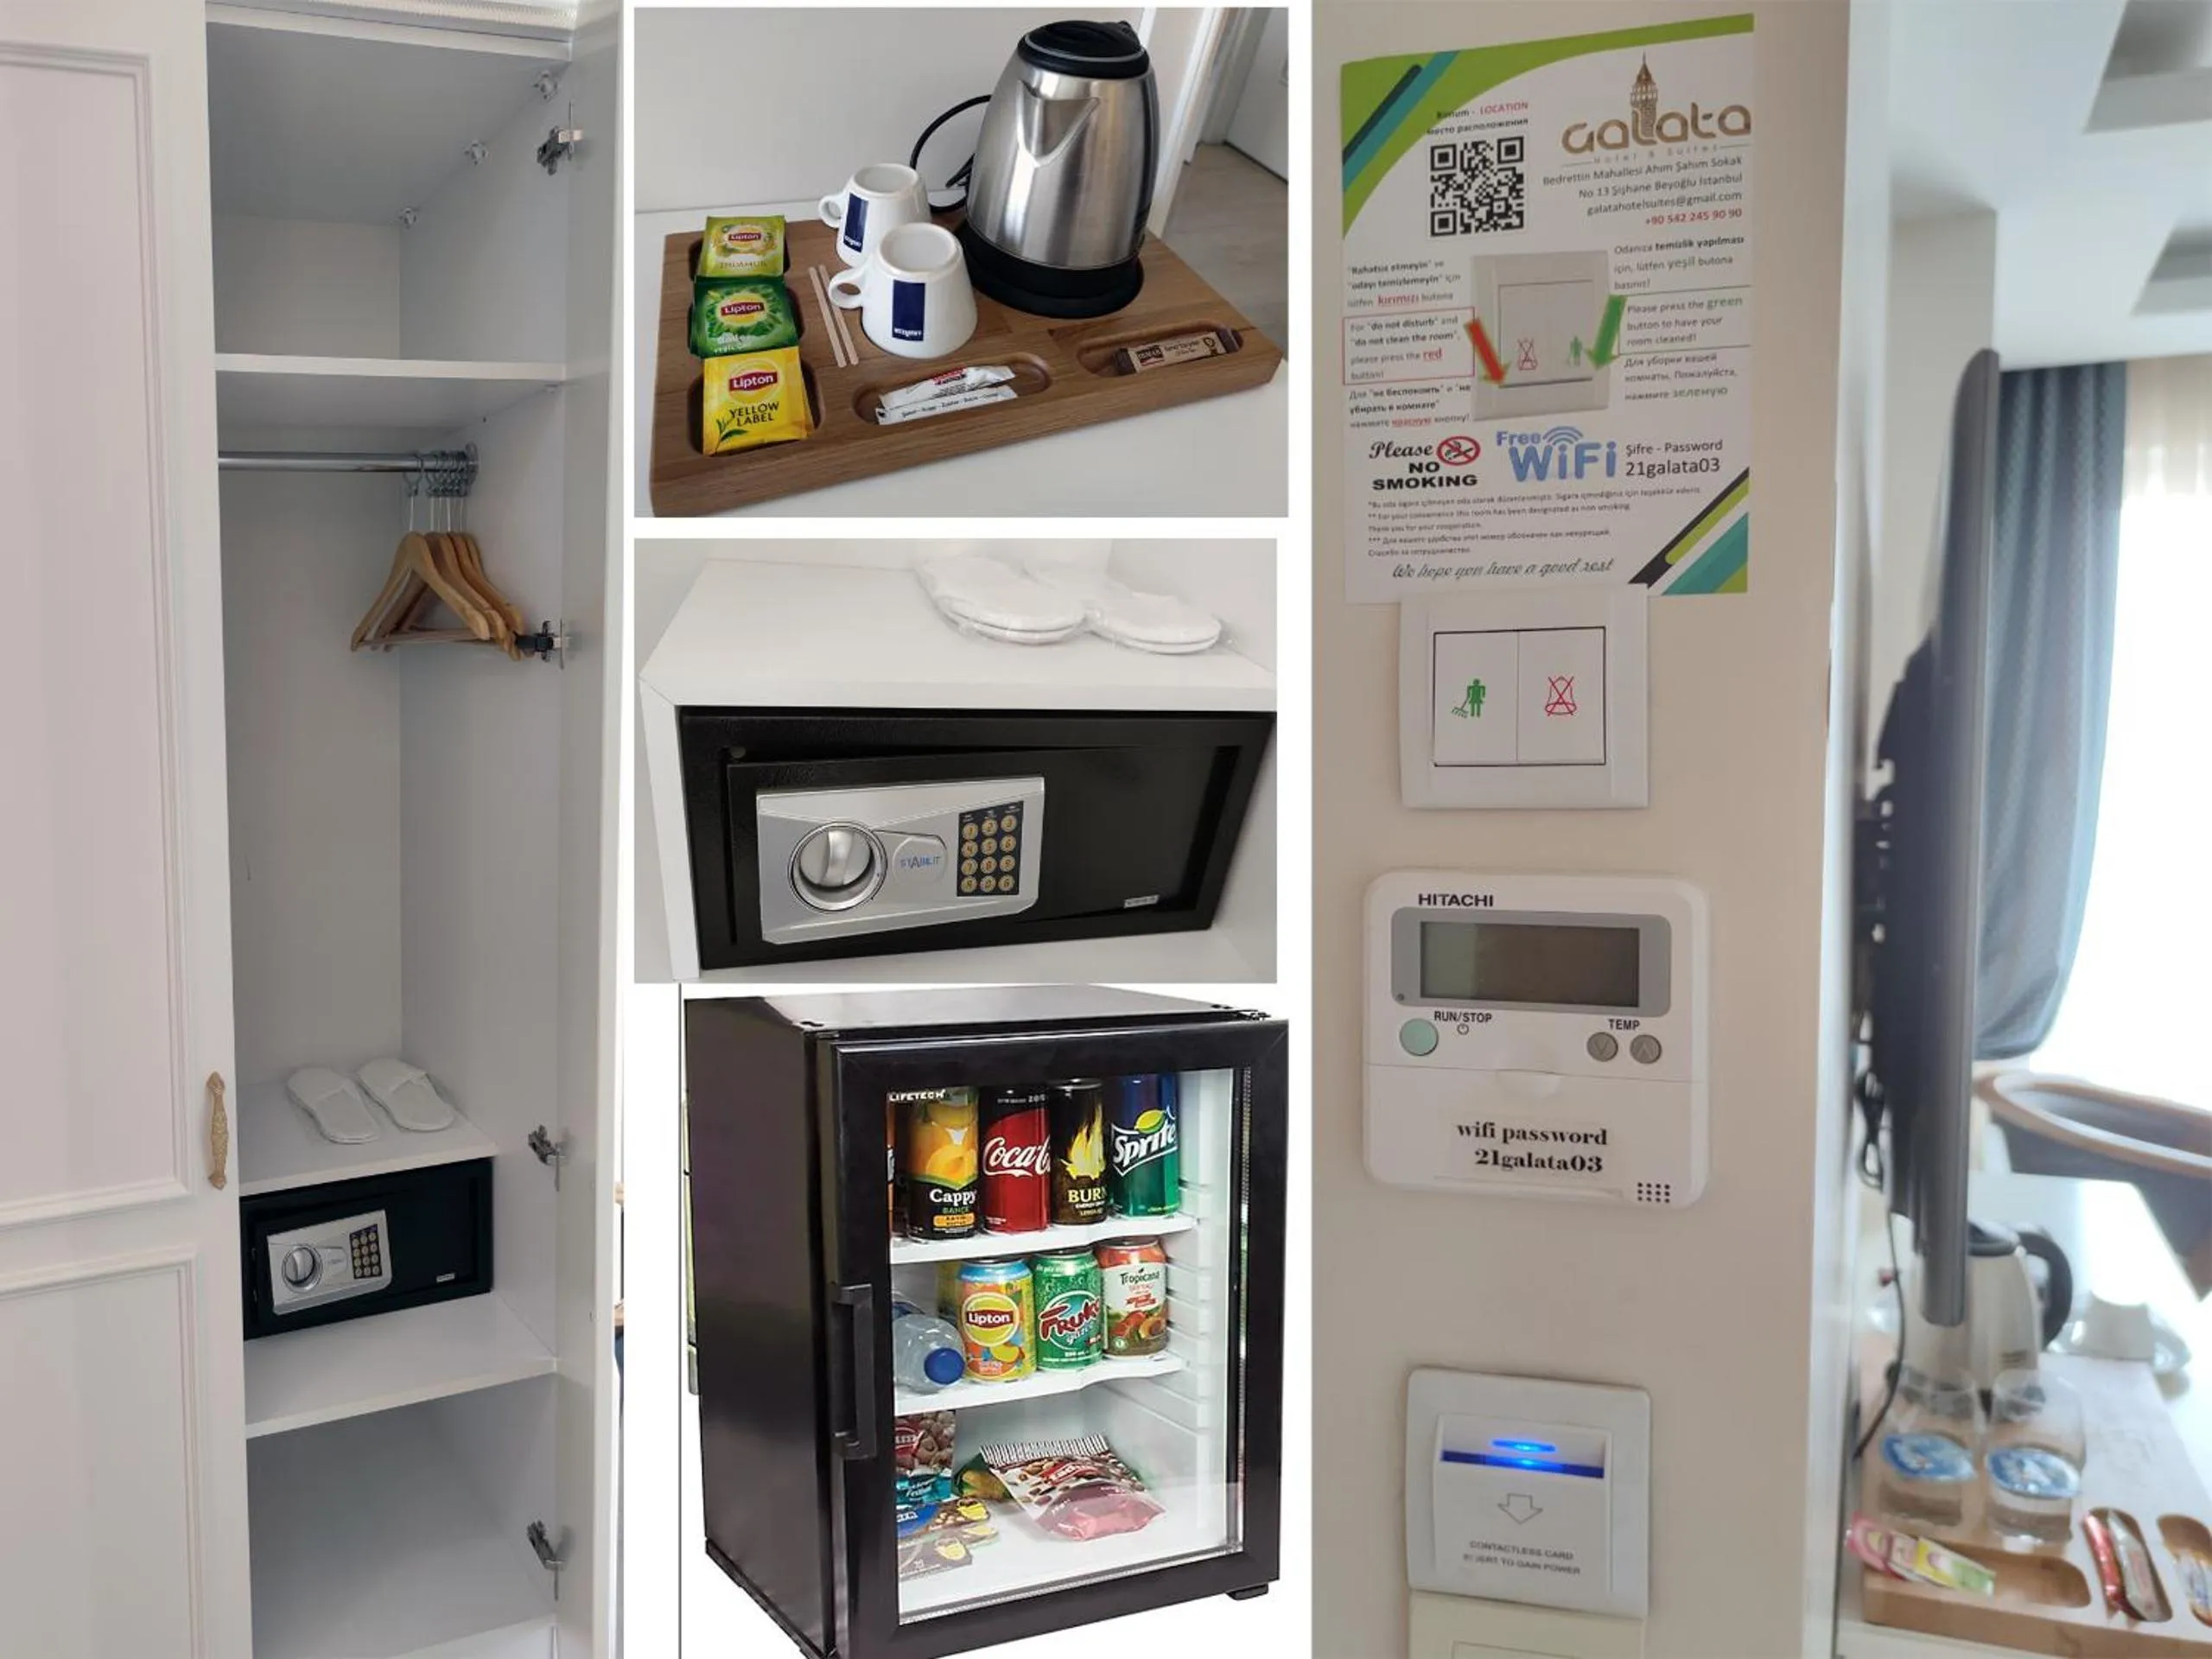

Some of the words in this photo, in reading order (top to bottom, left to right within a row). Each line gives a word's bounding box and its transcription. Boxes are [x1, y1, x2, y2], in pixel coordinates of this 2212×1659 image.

[1480, 101, 1529, 115] LOCATION
[1543, 173, 1591, 186] Bedrettin
[1593, 168, 1642, 180] Mahallesi
[1711, 156, 1742, 167] Sokak
[1579, 189, 1593, 199] No
[1598, 187, 1609, 197] 13
[1586, 191, 1742, 217] galatahotelsuites@gmail.com
[1646, 214, 1664, 226] +90
[1713, 210, 1726, 219] 90
[1728, 208, 1742, 218] 90
[1656, 238, 1694, 251] temizlik
[1698, 255, 1733, 265] butona
[724, 304, 761, 315] Lipton
[1627, 304, 1656, 314] Please
[1660, 302, 1685, 314] press
[1688, 299, 1704, 309] the
[1707, 296, 1743, 310] green
[1385, 321, 1400, 329] not
[1440, 315, 1459, 325] and
[1627, 320, 1660, 331] button
[1662, 319, 1672, 329] to
[1675, 316, 1698, 327] have
[1700, 316, 1722, 328] your
[1368, 336, 1383, 346] not
[1386, 333, 1410, 344] clean
[1411, 332, 1427, 342] the
[1627, 337, 1652, 346] room
[1656, 334, 1696, 345] cleaned!
[1350, 353, 1378, 366] please
[1381, 353, 1404, 365] press
[1406, 350, 1421, 360] the
[1422, 347, 1443, 360] red
[734, 372, 774, 390] Lipton
[729, 401, 779, 418] YELLOW
[736, 412, 775, 427] LABEL
[1497, 430, 1541, 446] Free
[1368, 435, 1433, 460] Please
[1625, 442, 1653, 457] Şifre
[1664, 439, 1723, 454] Password
[1408, 461, 1440, 474] NO
[1510, 441, 1618, 484] WiFi
[1624, 457, 1720, 480] 21galata03
[1372, 474, 1478, 491] SMOKING
[1392, 562, 1414, 579] We
[1417, 562, 1452, 582] hope
[1454, 566, 1487, 582] you
[1491, 561, 1522, 577] have
[1525, 564, 1536, 575] a
[1539, 558, 1578, 579] good
[1418, 893, 1494, 907] HITACHI
[1433, 1010, 1493, 1023] RUN/STOP
[1608, 1018, 1641, 1031] TEMP
[888, 1089, 946, 1102] LIFETECH
[1457, 1121, 1497, 1139] wifi
[1502, 1124, 1608, 1147] password
[1113, 1121, 1179, 1168] Sprite
[1474, 1148, 1604, 1173] 21galata03
[929, 1188, 977, 1206] Cappy
[967, 1313, 1011, 1326] Lipton
[1469, 1541, 1541, 1557] CONTACTLESS
[1545, 1549, 1573, 1560] CARD
[1501, 1557, 1514, 1567] TO
[1516, 1560, 1541, 1569] GAIN
[1543, 1564, 1580, 1574] POWER
